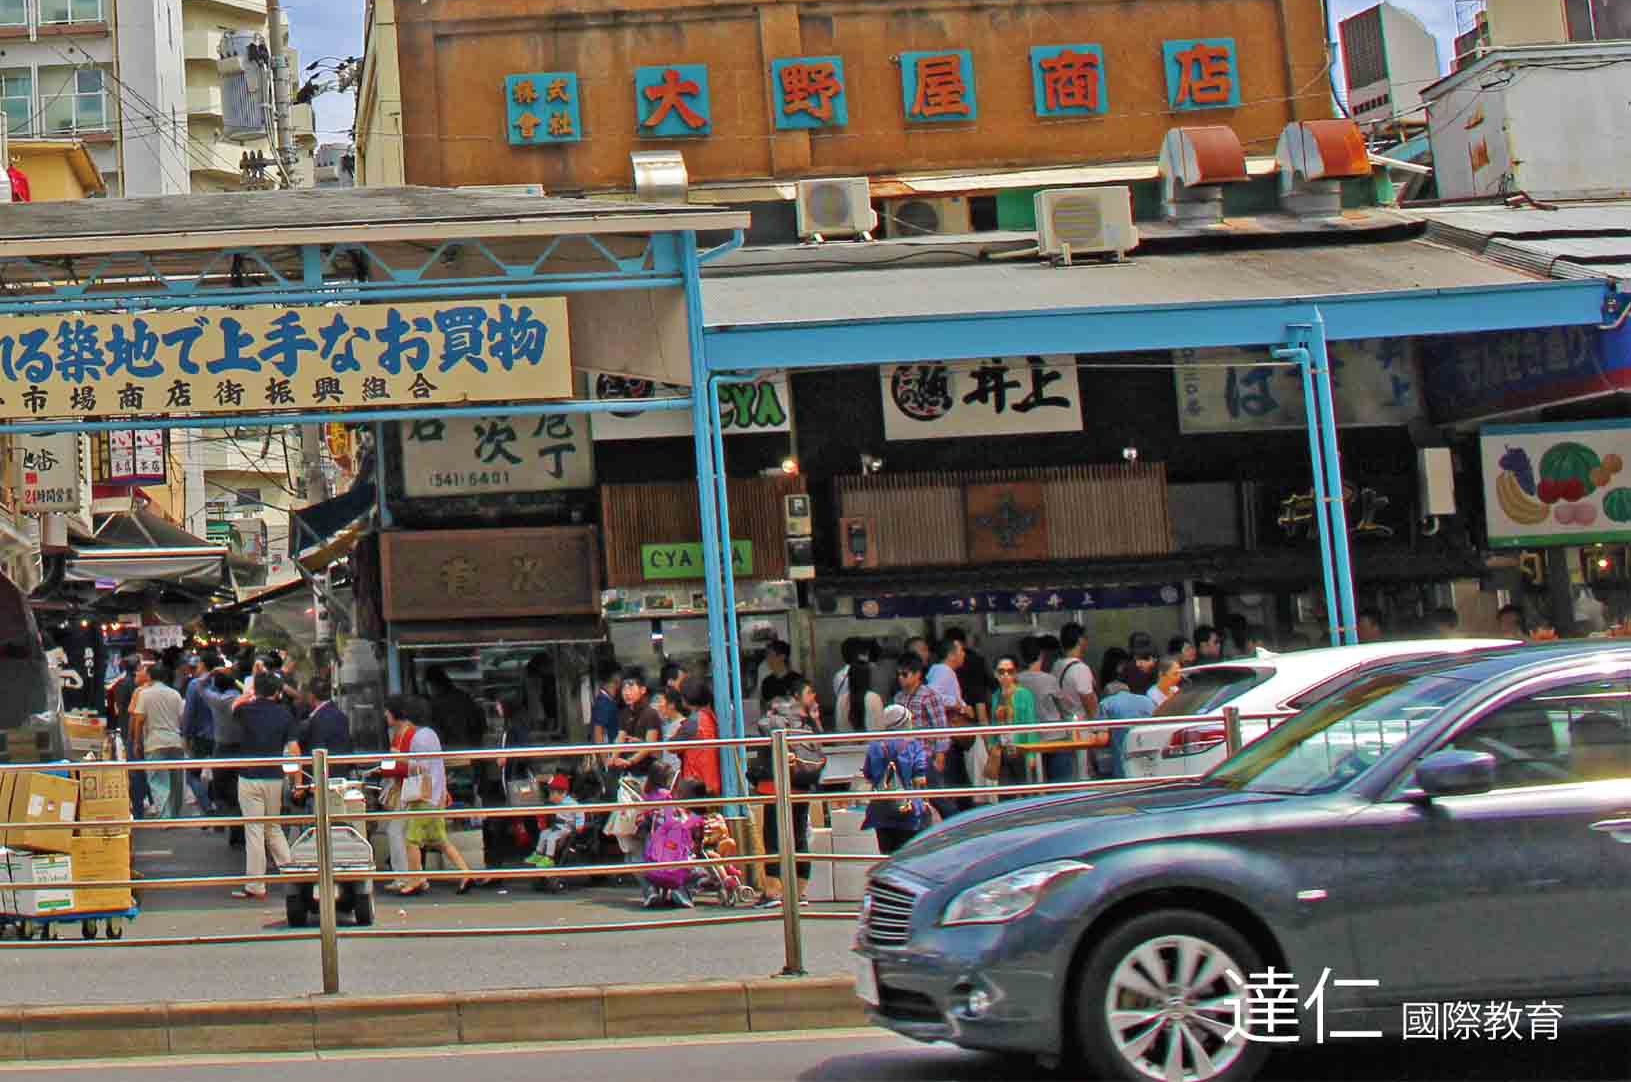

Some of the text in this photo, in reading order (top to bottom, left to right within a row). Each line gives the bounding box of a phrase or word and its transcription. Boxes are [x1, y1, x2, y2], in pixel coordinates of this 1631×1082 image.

[643, 43, 1231, 128] 大野屋商店
[649, 549, 694, 569] CYA
